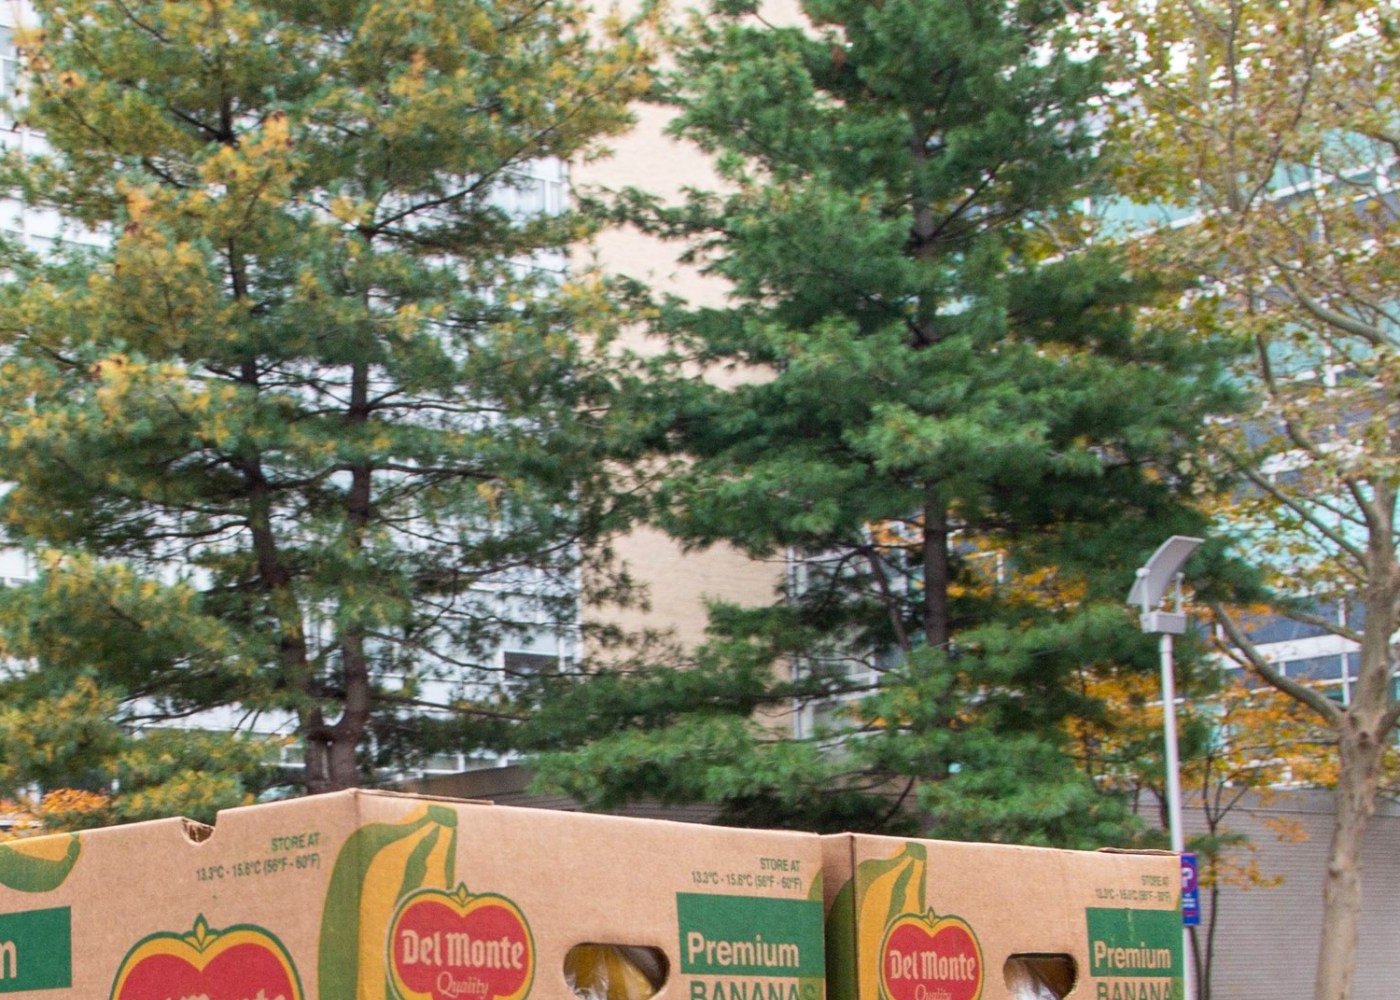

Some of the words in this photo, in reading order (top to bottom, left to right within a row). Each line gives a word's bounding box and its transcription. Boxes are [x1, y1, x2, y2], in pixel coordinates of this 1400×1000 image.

[271, 835, 305, 852] STORE
[308, 832, 320, 846] AT
[760, 857, 789, 871] STORE
[791, 860, 800, 872] AT
[401, 929, 442, 965] Del
[446, 929, 524, 971] Monte
[687, 931, 800, 968] Premium
[1094, 941, 1171, 968] Premium
[889, 948, 917, 980] Del
[921, 951, 976, 981] Monte
[436, 970, 489, 999] Quality
